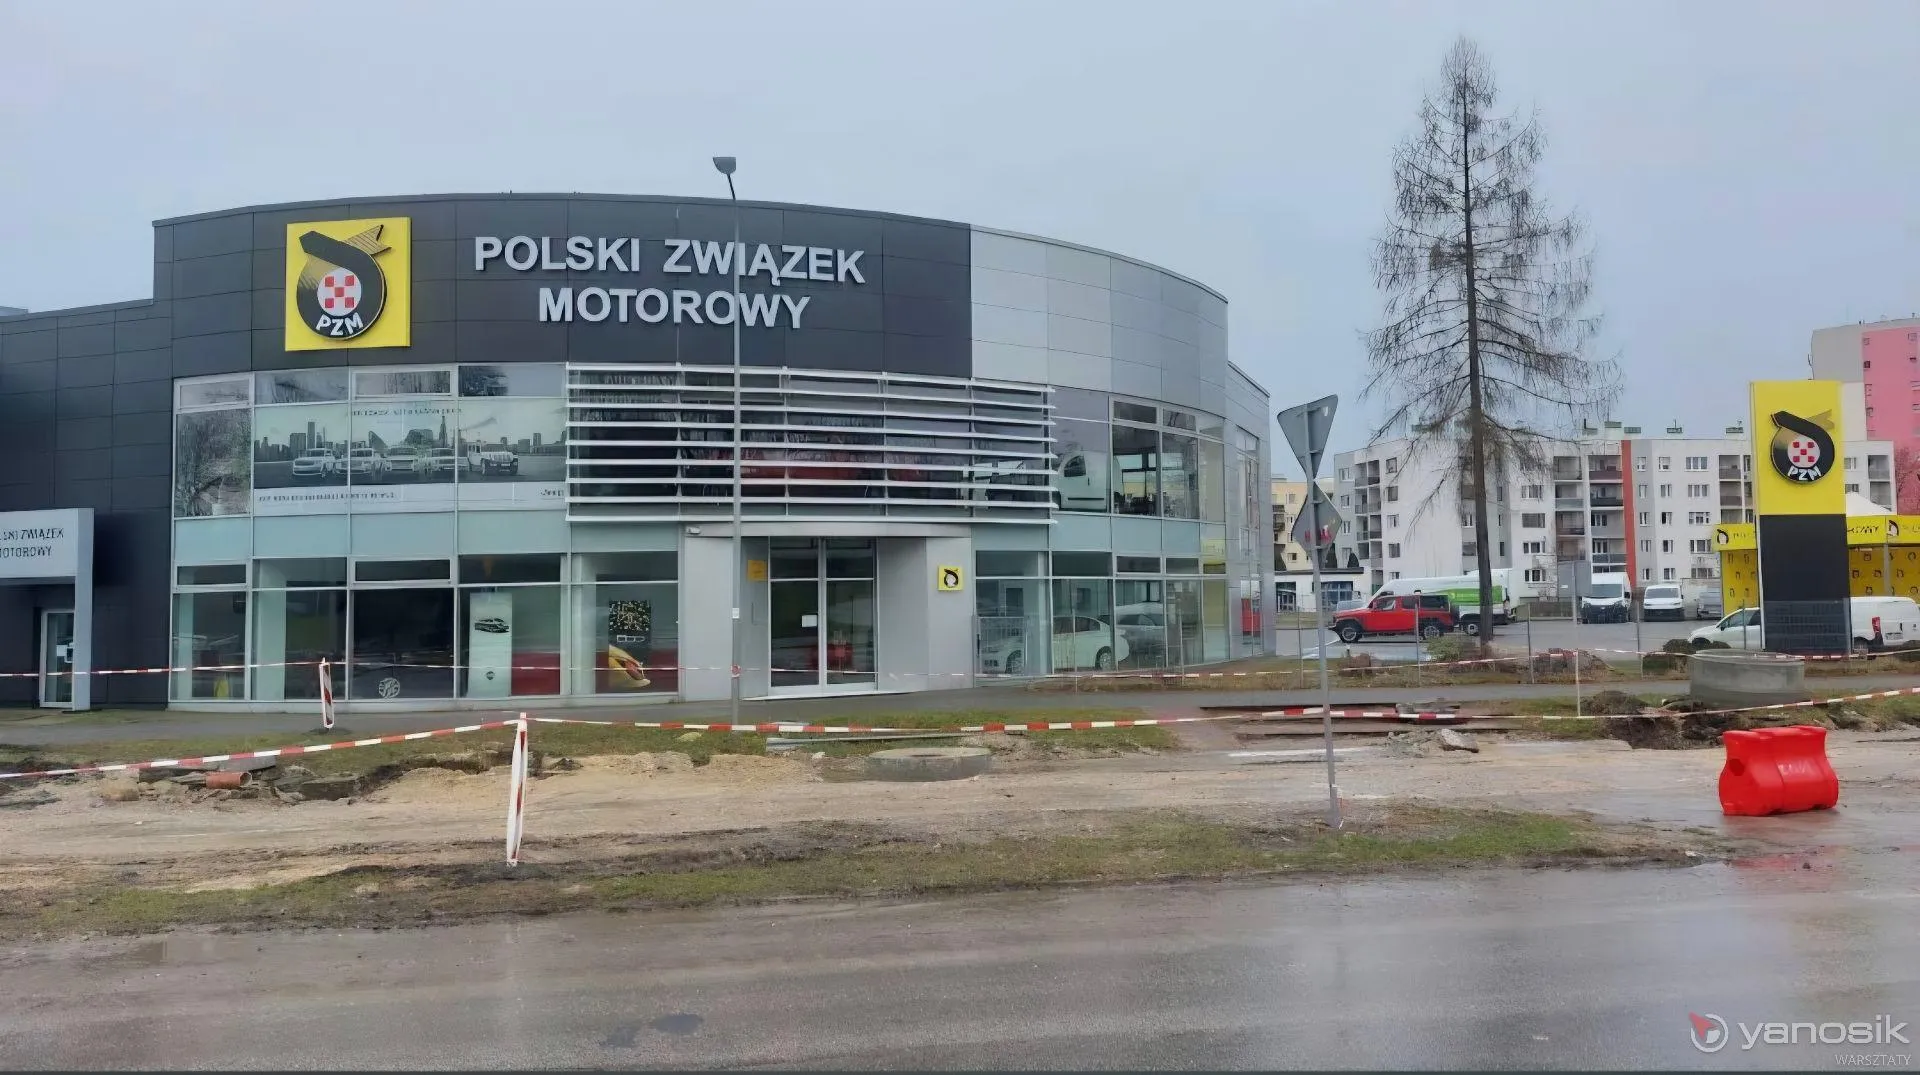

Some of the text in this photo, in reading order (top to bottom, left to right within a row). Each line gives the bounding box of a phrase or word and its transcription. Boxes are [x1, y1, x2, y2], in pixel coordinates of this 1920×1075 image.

[475, 235, 866, 287] POLSKI ZWIĄZEK
[315, 311, 364, 336] PZM
[538, 286, 811, 329] MOTOROWY
[1787, 466, 1822, 481] PZM
